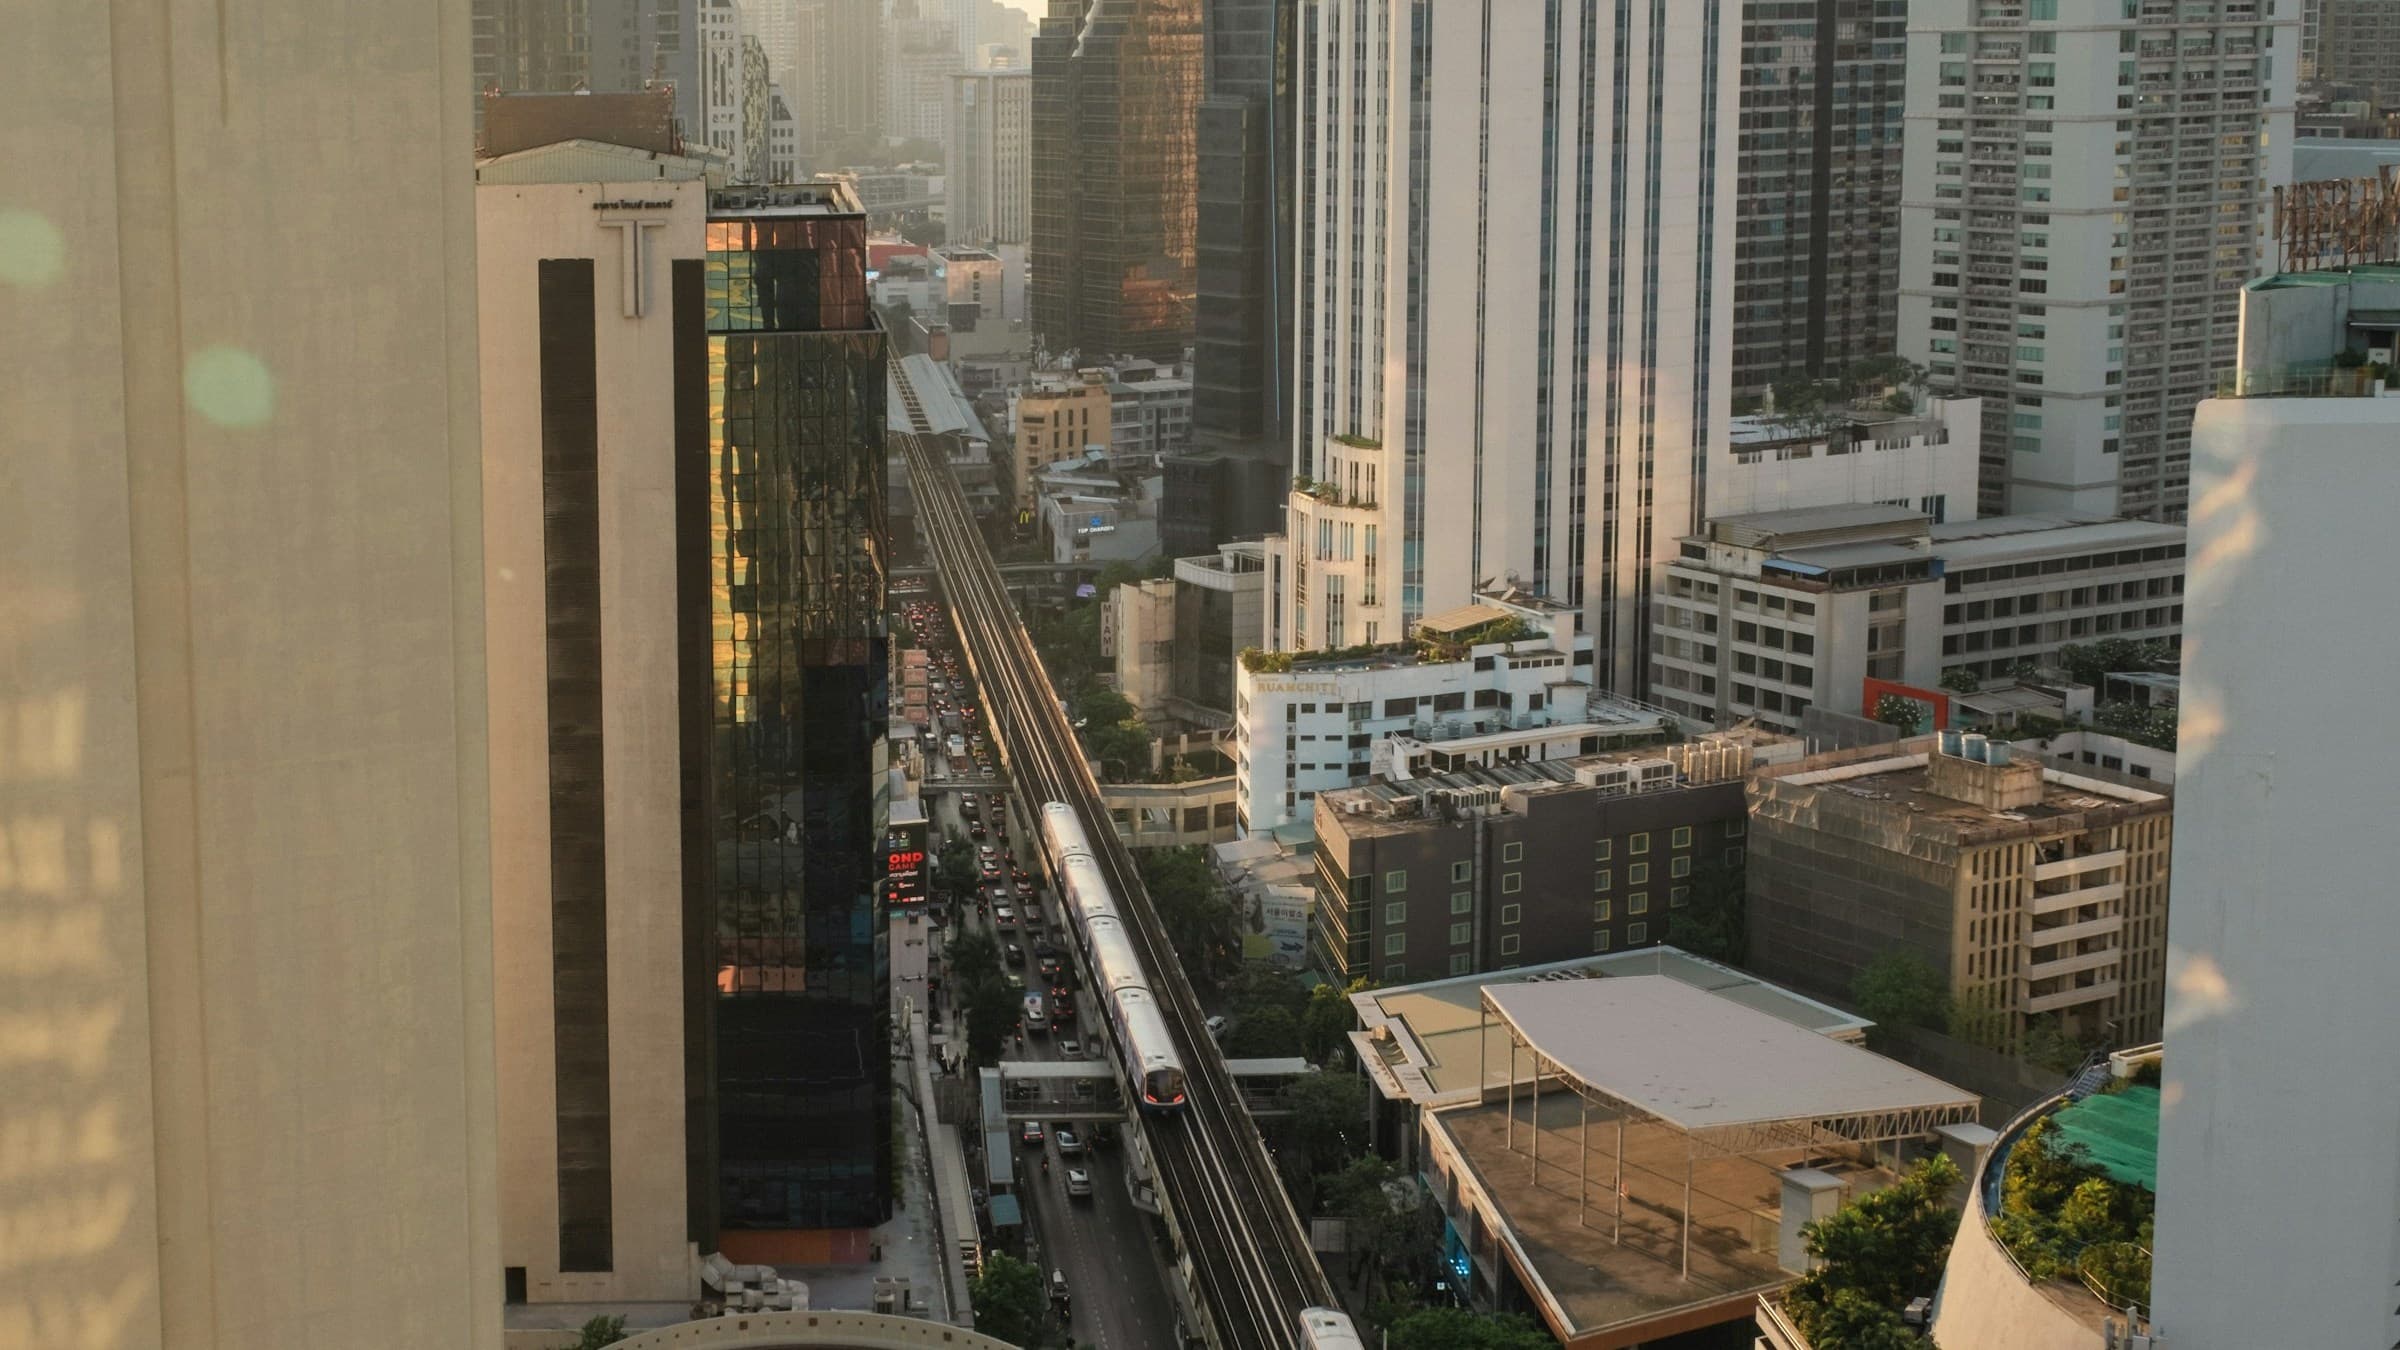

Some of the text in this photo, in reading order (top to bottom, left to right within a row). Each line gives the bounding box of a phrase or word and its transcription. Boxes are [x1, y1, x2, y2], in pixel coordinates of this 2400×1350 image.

[598, 219, 666, 319] T
[1103, 603, 1111, 657] MIAMI
[889, 852, 923, 863] OND
